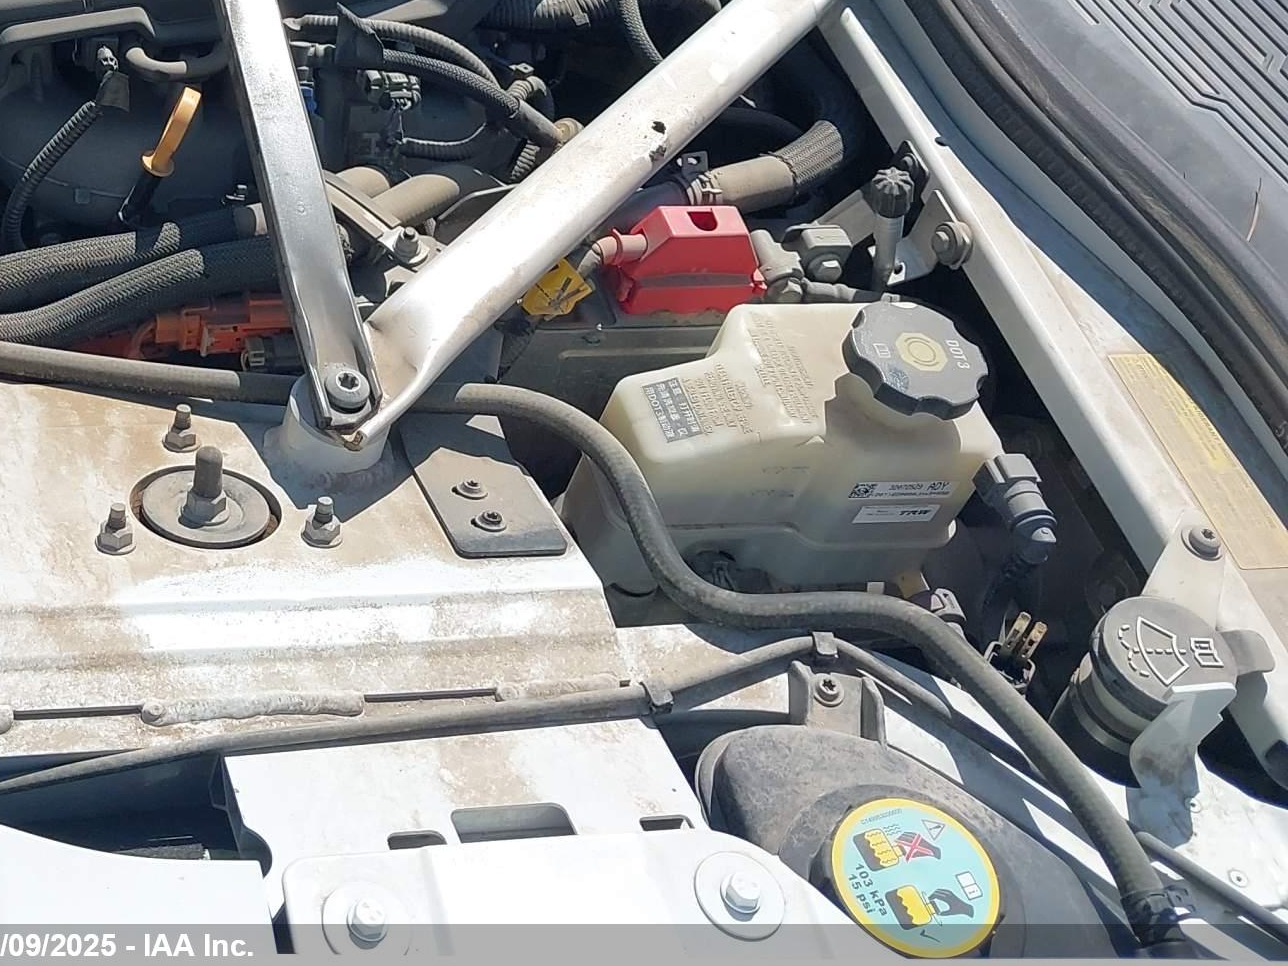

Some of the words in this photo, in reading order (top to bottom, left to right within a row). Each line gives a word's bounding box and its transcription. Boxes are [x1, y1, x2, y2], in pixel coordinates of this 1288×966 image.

[848, 873, 863, 890] 15
[856, 894, 876, 914] psi
[855, 863, 874, 887] 103
[870, 890, 888, 916] kPa
